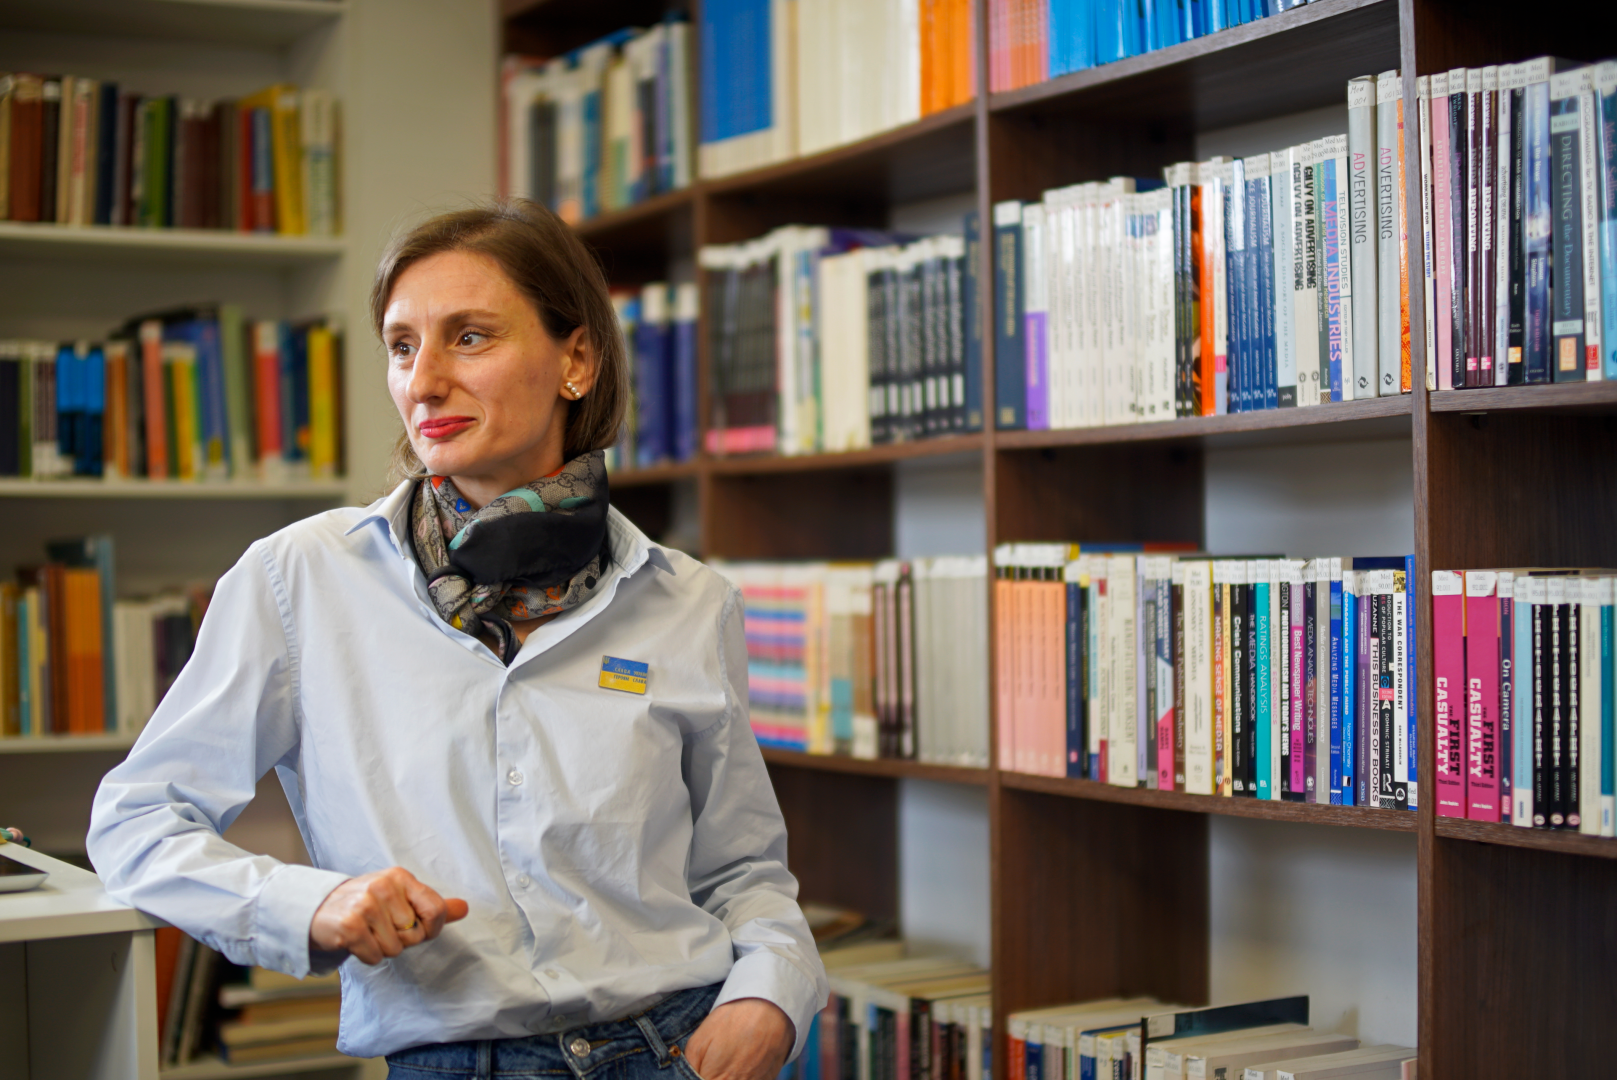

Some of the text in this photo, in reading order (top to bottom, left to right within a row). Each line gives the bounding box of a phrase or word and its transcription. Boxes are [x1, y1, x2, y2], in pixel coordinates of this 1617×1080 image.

[1350, 84, 1365, 94] Med
[1533, 109, 1542, 146] Reporting
[1584, 96, 1592, 164] PROGRAMMING
[1604, 121, 1616, 160] Media
[1354, 152, 1366, 244] ADVERTISING
[1380, 148, 1392, 240] ADVERTISING
[1499, 166, 1507, 198] advertising
[1606, 166, 1617, 209] Selling
[1294, 202, 1302, 217] ON
[1304, 166, 1316, 289] GILVY ON ADVERTISING
[1454, 213, 1462, 229] OF
[1562, 136, 1574, 317] DIRECTING the Documentary
[1294, 221, 1304, 291] ADVERTISING
[1325, 201, 1342, 362] MEDIA INDUSTRIES
[1294, 630, 1302, 649] Best
[1292, 651, 1302, 698] Newspaper
[1502, 659, 1511, 731] On Camera
[1552, 604, 1560, 768] PHOTOGRAPHY
[1125, 702, 1135, 744] CONSENT
[1216, 698, 1222, 713] OF
[1293, 700, 1302, 731] Writing
[1437, 677, 1448, 775] CASUALTY
[1470, 678, 1481, 778] CASUALTY
[1372, 738, 1378, 756] OF
[1449, 719, 1460, 776] FIRST
[1483, 721, 1494, 778] FIRST
